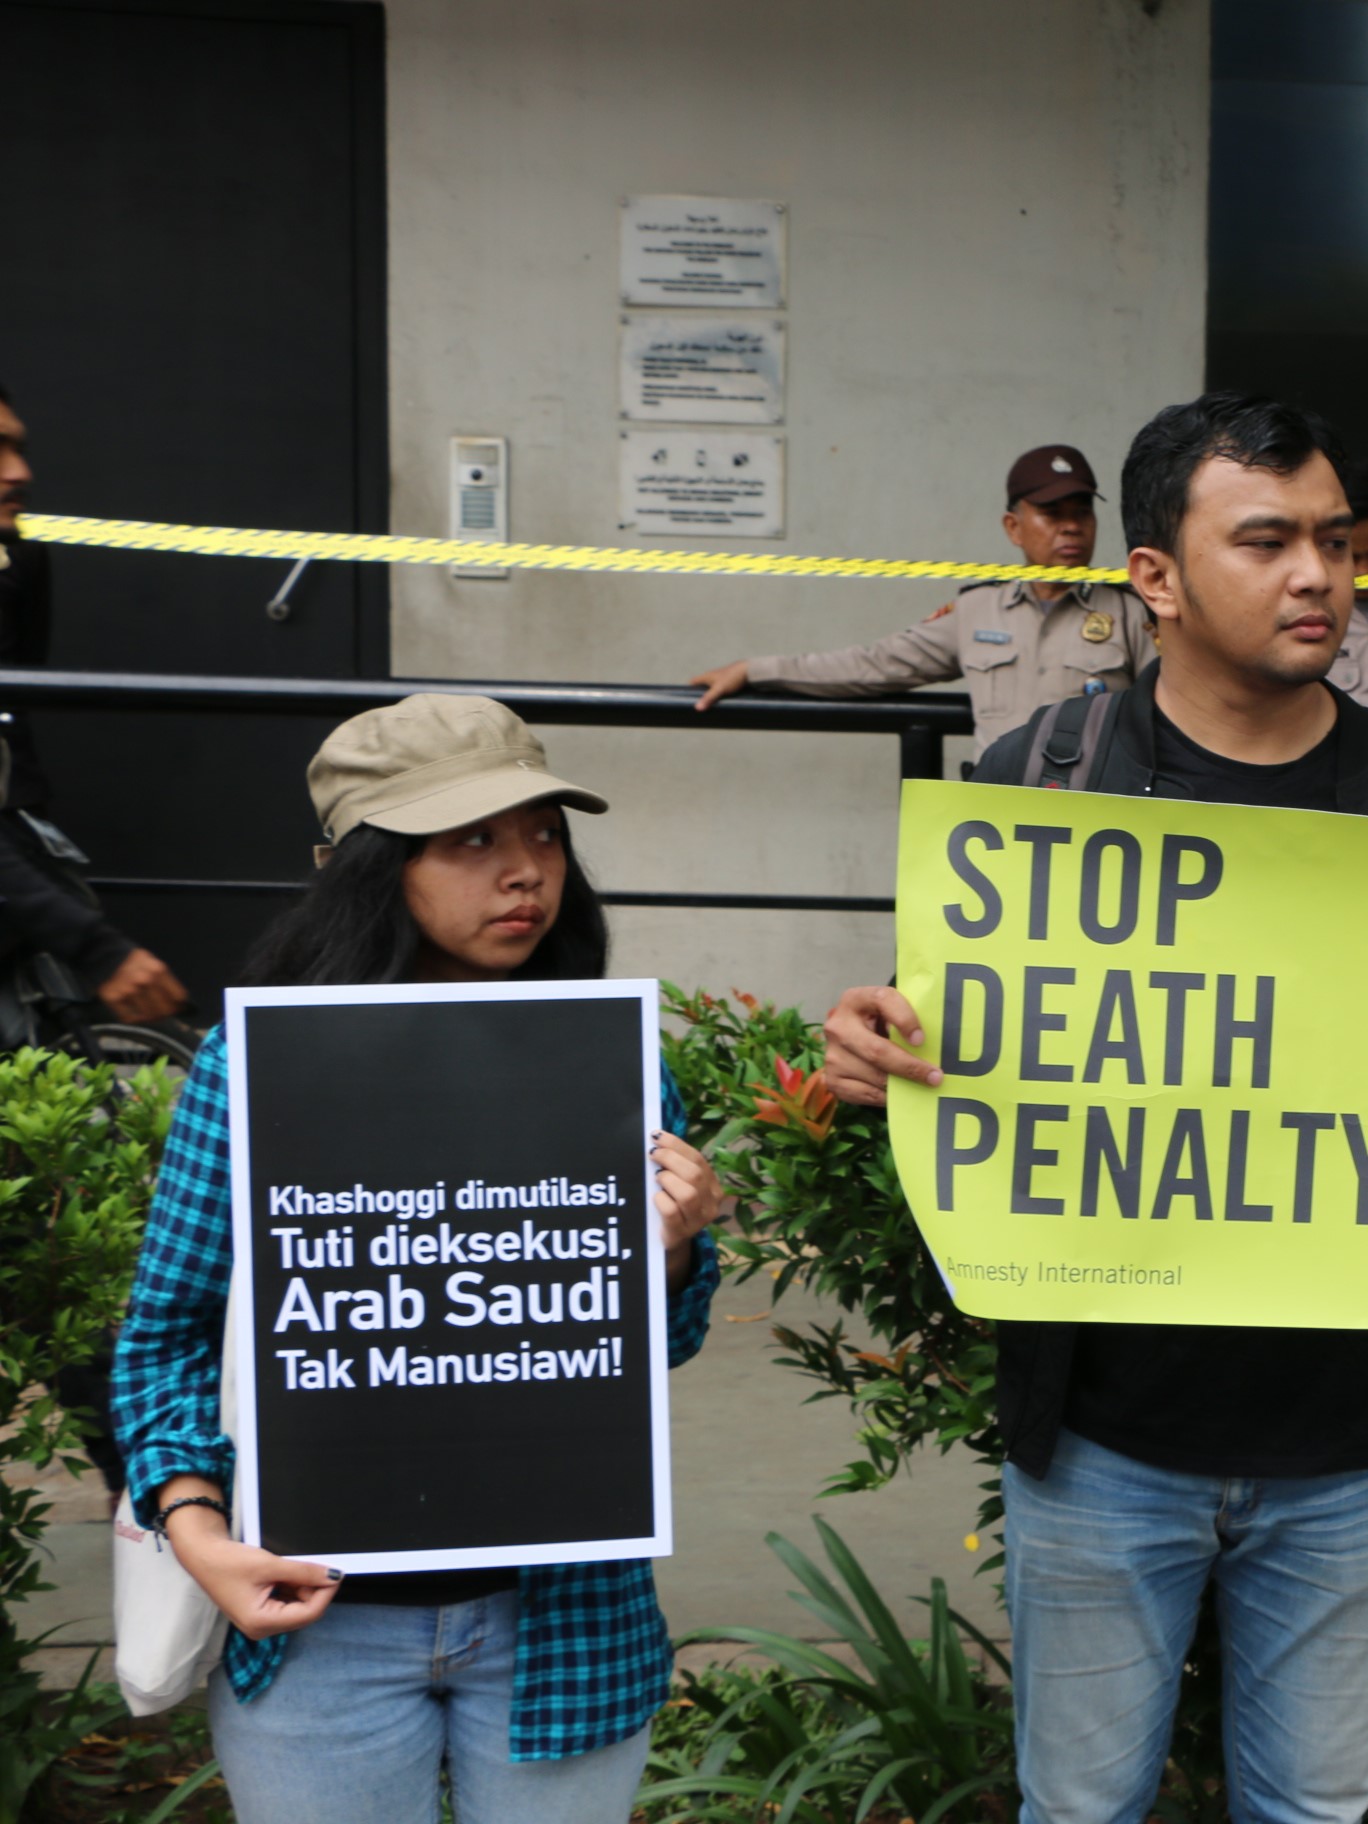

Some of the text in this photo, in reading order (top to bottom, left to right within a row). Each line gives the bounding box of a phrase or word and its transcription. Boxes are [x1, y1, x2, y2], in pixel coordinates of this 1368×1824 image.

[942, 820, 1225, 947] STOP
[939, 962, 1276, 1089] DEATH
[269, 1176, 626, 1220] Khashoggi dimutilasi,
[271, 1217, 632, 1269] Tuti dieksekusi,
[946, 1256, 1182, 1286] Amnesty International
[273, 1266, 620, 1333] Arab Saudi
[276, 1337, 623, 1390] Tak Manusiawi!
